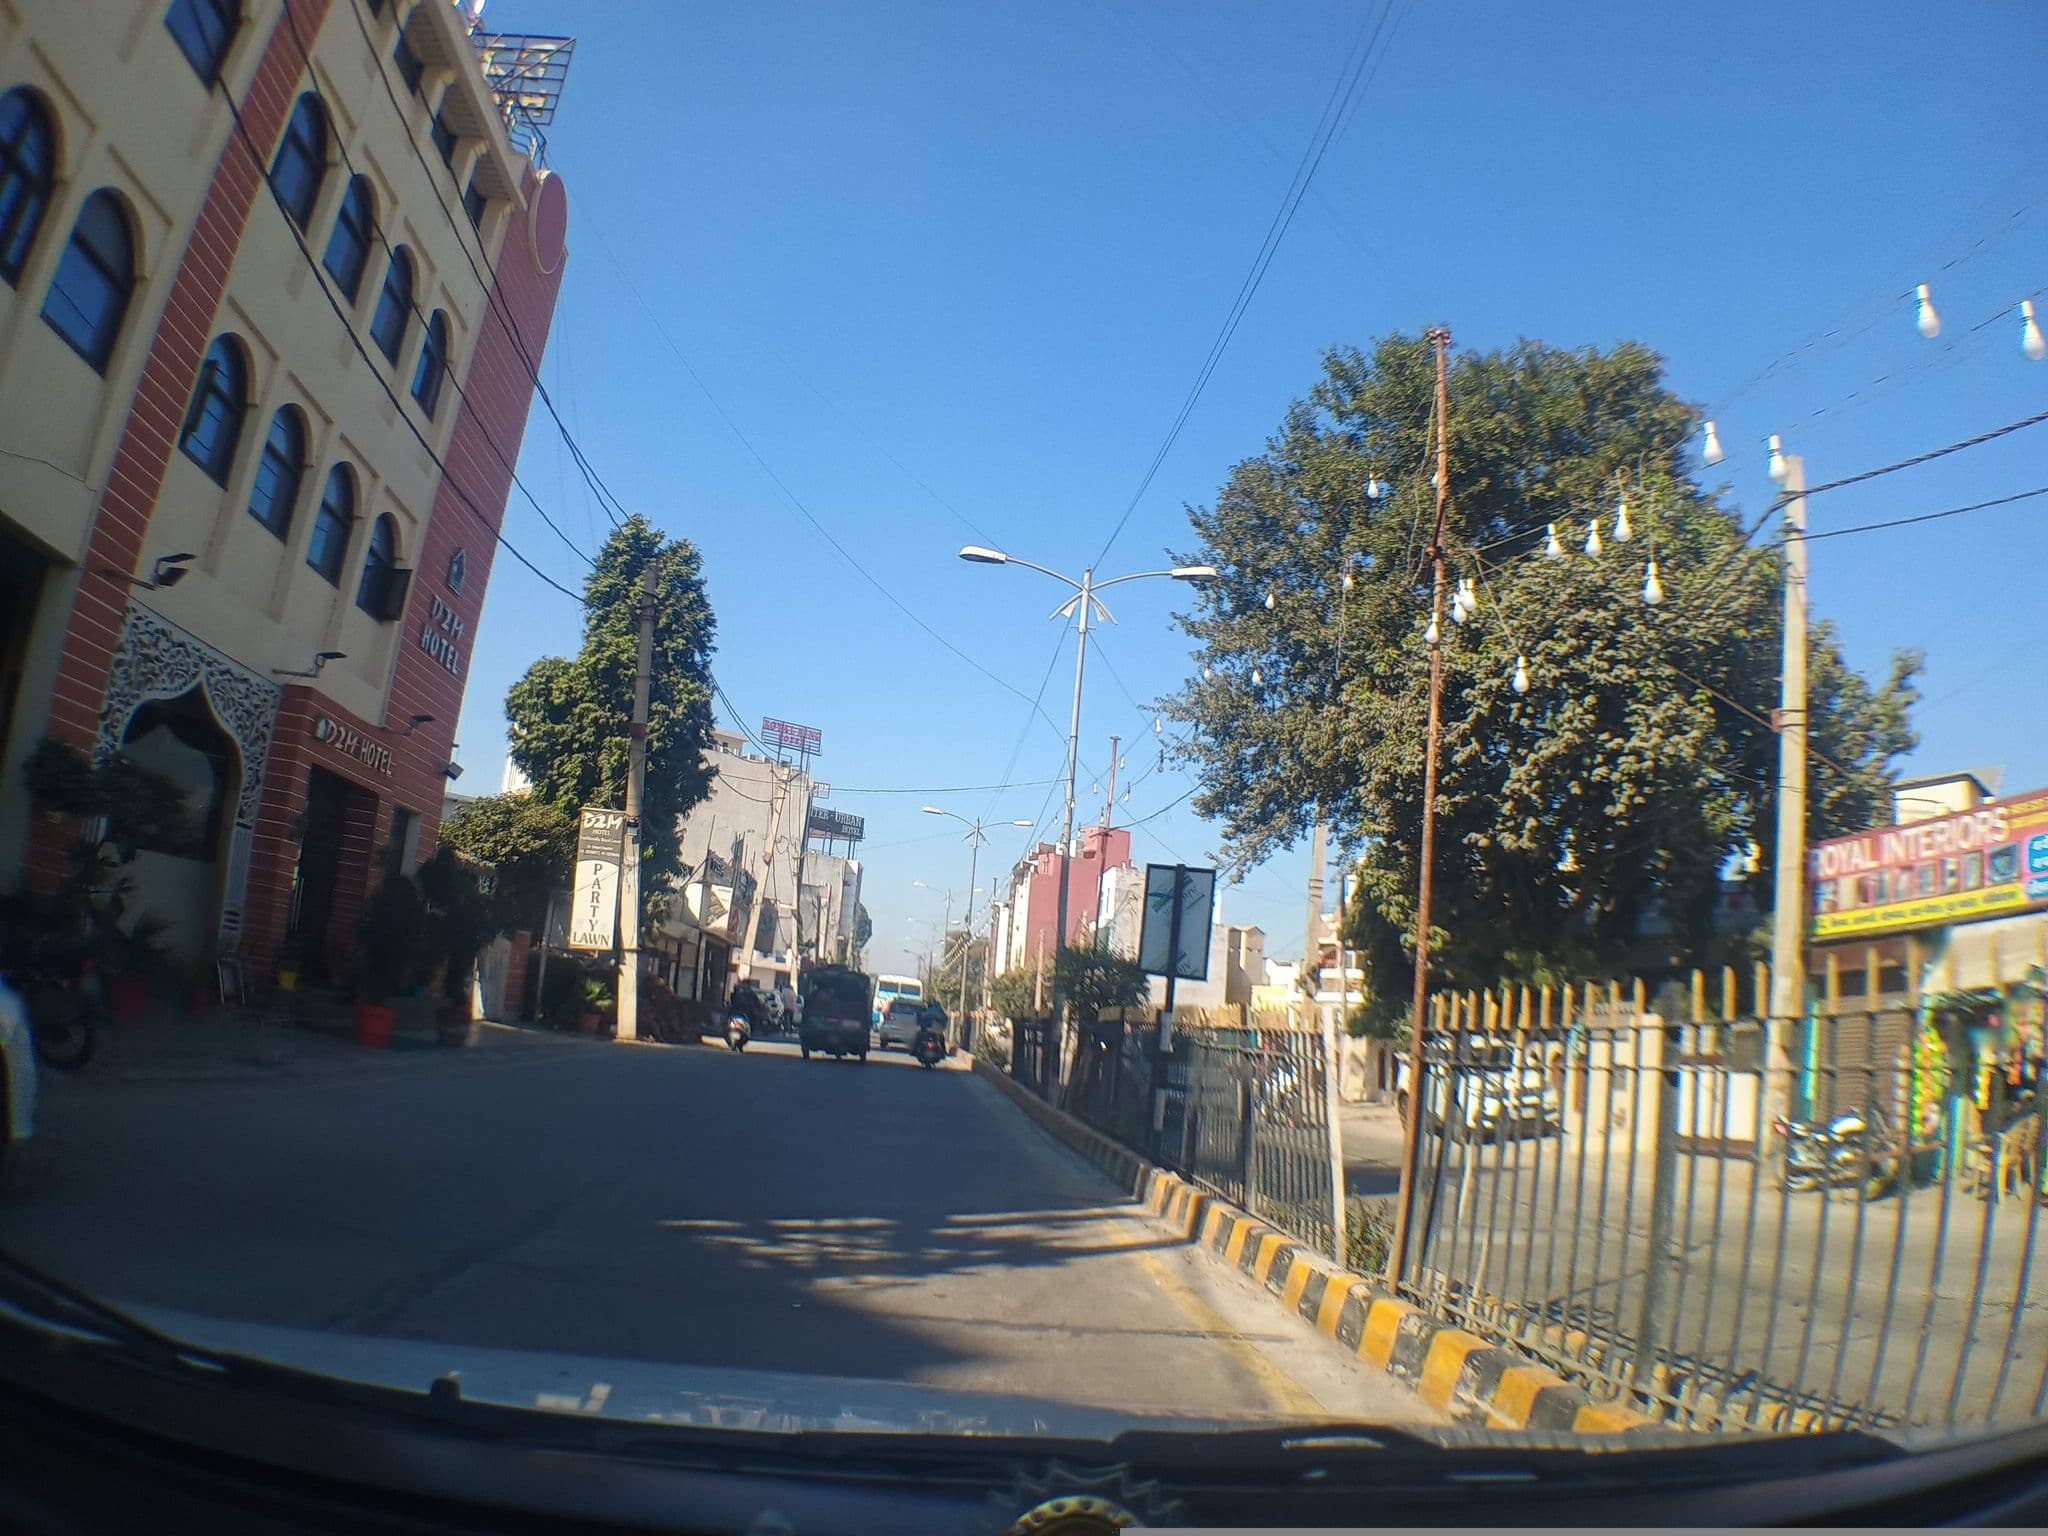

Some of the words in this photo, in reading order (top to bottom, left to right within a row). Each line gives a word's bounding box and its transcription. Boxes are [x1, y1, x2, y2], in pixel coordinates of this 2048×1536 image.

[432, 594, 464, 639] D2M
[421, 625, 458, 675] HOTEL
[326, 719, 360, 754] D2M
[360, 738, 393, 777] HOTEL
[835, 812, 862, 827] URBAN
[841, 825, 861, 836] HOTEL
[1880, 806, 2012, 865] INTERIORS
[588, 863, 603, 932] PARTY
[572, 930, 610, 947] LAWN
